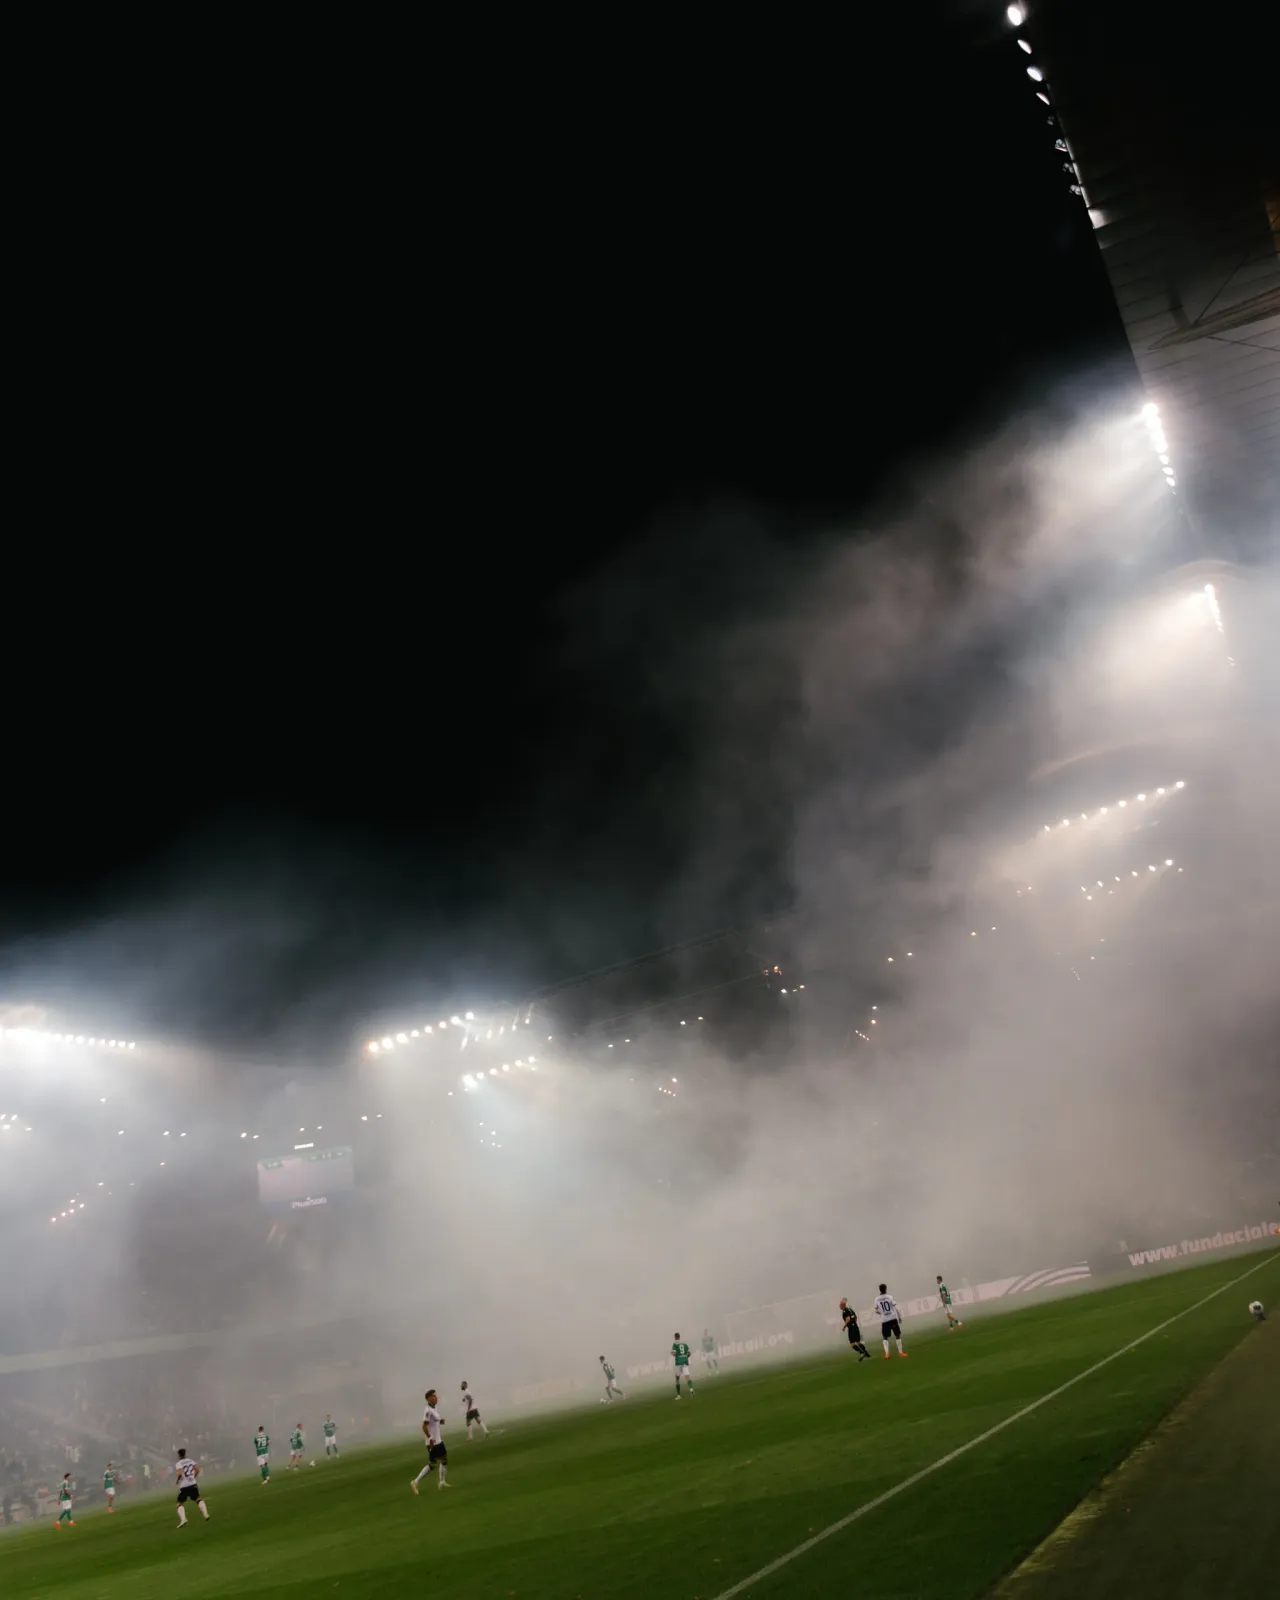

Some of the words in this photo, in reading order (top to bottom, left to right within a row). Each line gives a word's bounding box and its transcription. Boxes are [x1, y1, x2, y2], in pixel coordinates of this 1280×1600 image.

[1128, 1221, 1280, 1267] www.fundacjale
[879, 1300, 891, 1313] 10
[679, 1344, 686, 1354] 9
[256, 1437, 267, 1447] 79
[182, 1463, 194, 1477] 22
